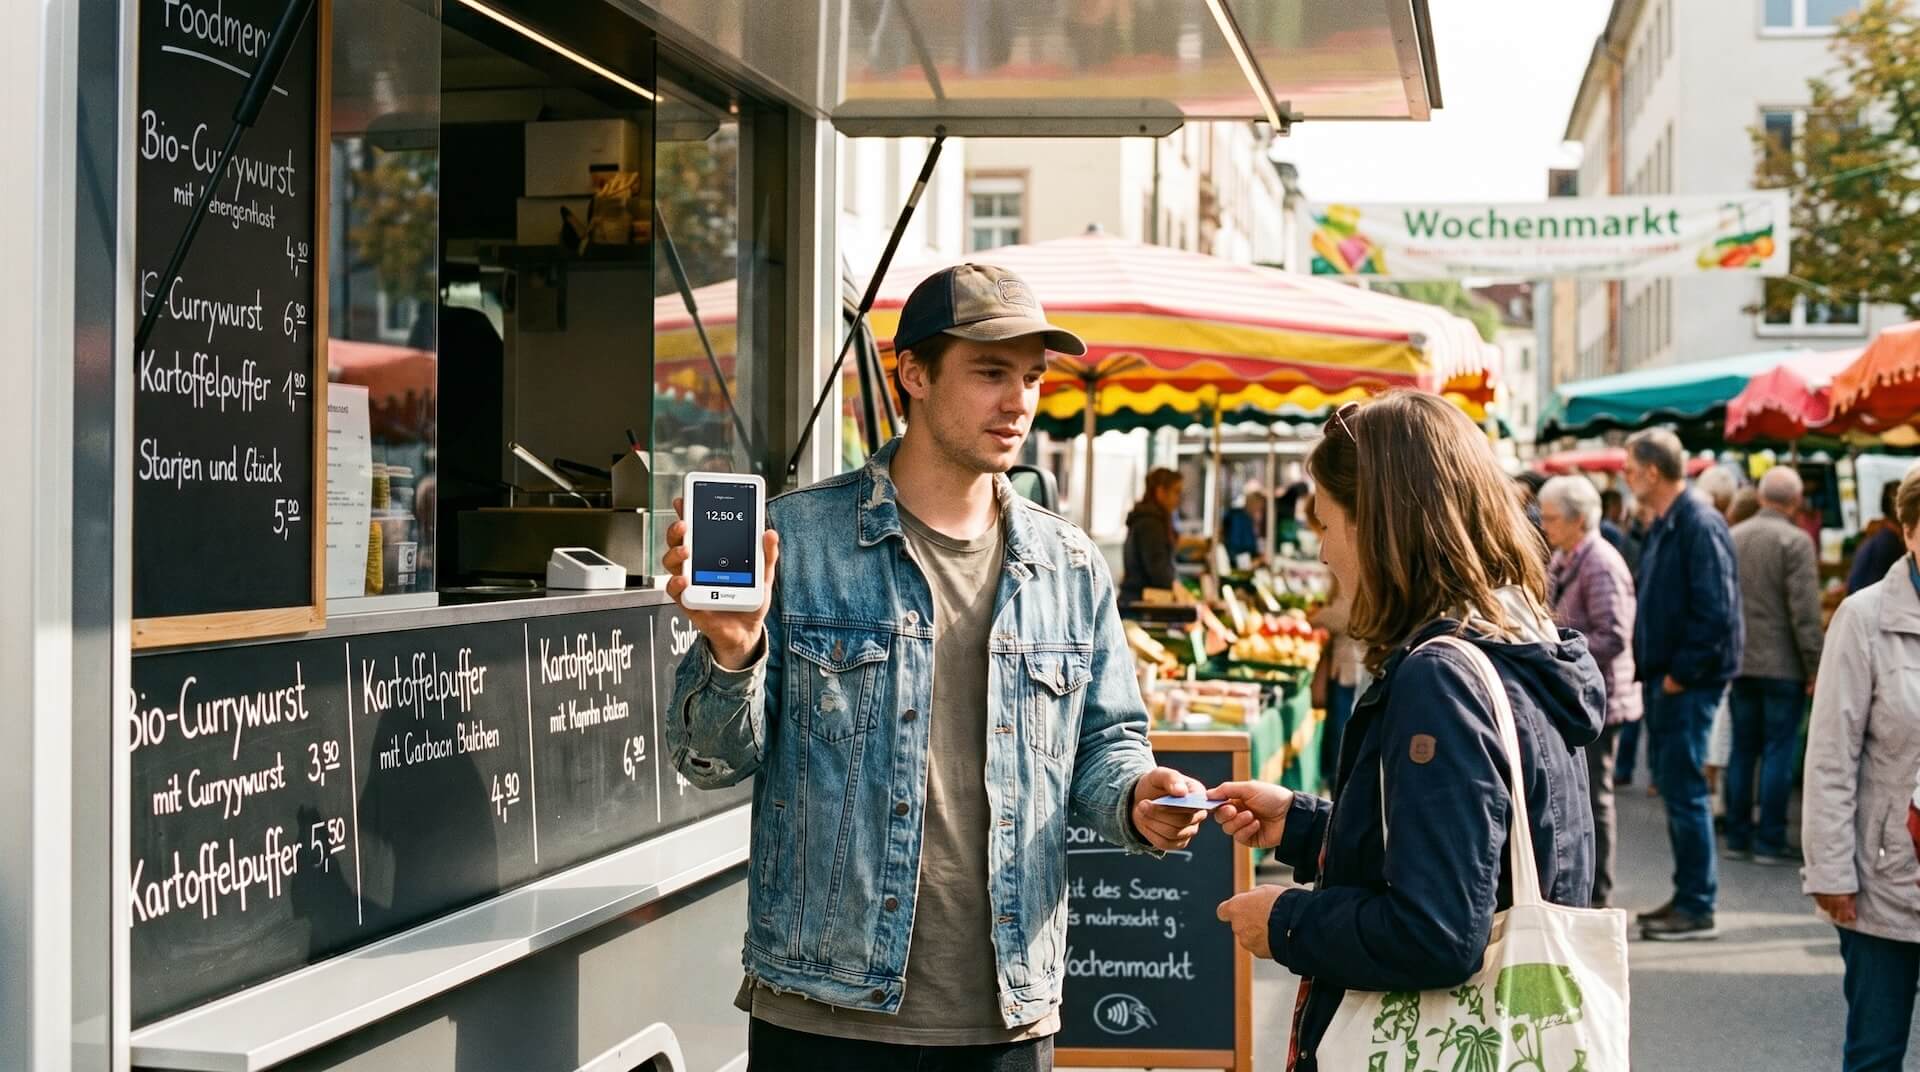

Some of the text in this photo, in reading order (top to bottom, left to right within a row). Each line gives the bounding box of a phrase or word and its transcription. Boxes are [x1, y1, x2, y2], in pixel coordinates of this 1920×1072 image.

[164, 0, 271, 58] Foodmen
[141, 109, 296, 197] Bio-Curywurst
[173, 182, 194, 207] mit
[1403, 206, 1681, 240] Wochenmarkt
[140, 349, 272, 413] Kartoffelpuffer
[209, 445, 238, 482] und
[705, 510, 744, 521] 12,50 €
[362, 647, 487, 721] Kartoffelpuffer
[540, 629, 634, 691] Kartoffelpuffer
[130, 661, 309, 761] Bio-Currywurst
[549, 702, 567, 734] mit
[153, 773, 183, 816] mit
[308, 740, 341, 786] 3,90
[380, 734, 401, 770] mit
[491, 771, 521, 823] 4,90
[129, 817, 346, 927] Kartoffelpuffer 5,50
